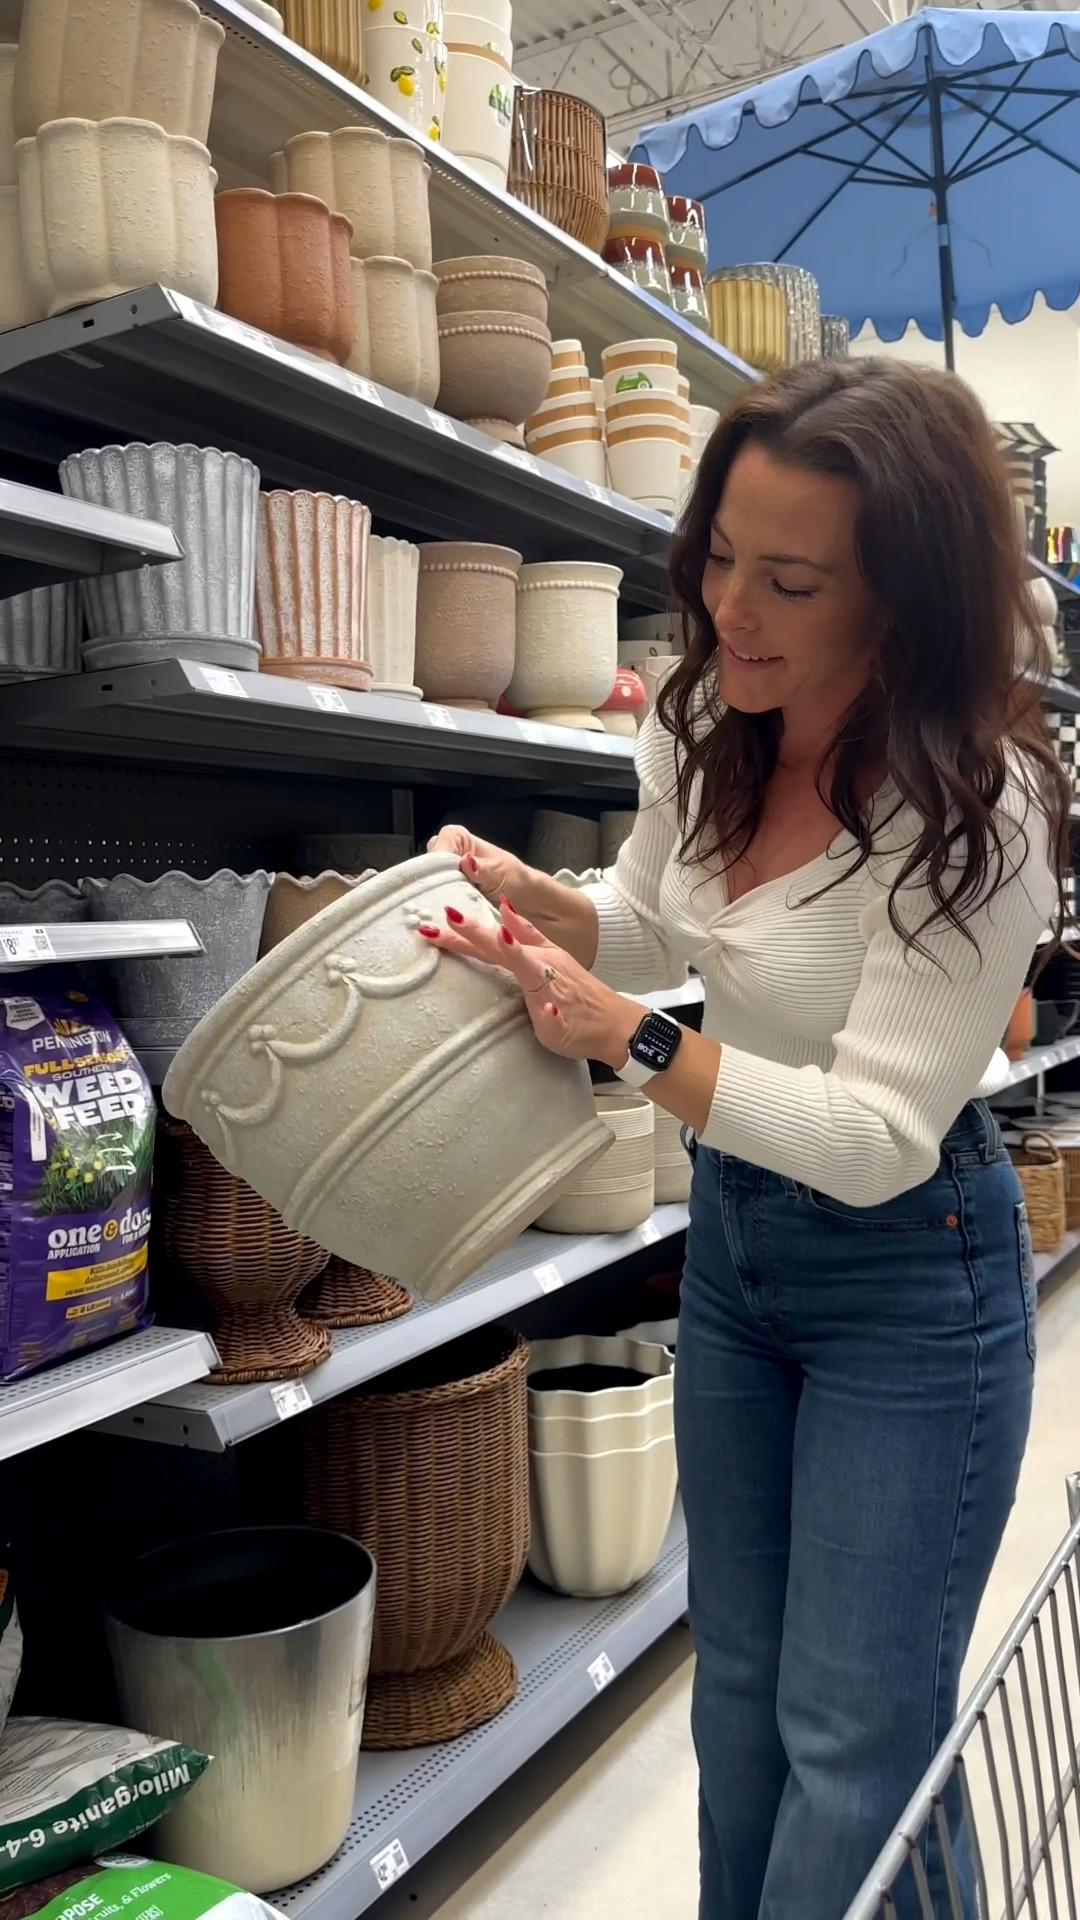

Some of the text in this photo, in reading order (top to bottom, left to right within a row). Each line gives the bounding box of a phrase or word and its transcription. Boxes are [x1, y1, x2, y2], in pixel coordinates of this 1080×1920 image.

[32, 1069, 142, 1108] WEED
[52, 1064, 114, 1081] SOUTHER
[53, 1094, 146, 1130] FEED
[47, 1243, 101, 1260] APPLICATION
[48, 1223, 102, 1249] one
[52, 1764, 191, 1835] Milorganite
[88, 1873, 172, 1920] ruits, & Flowers
